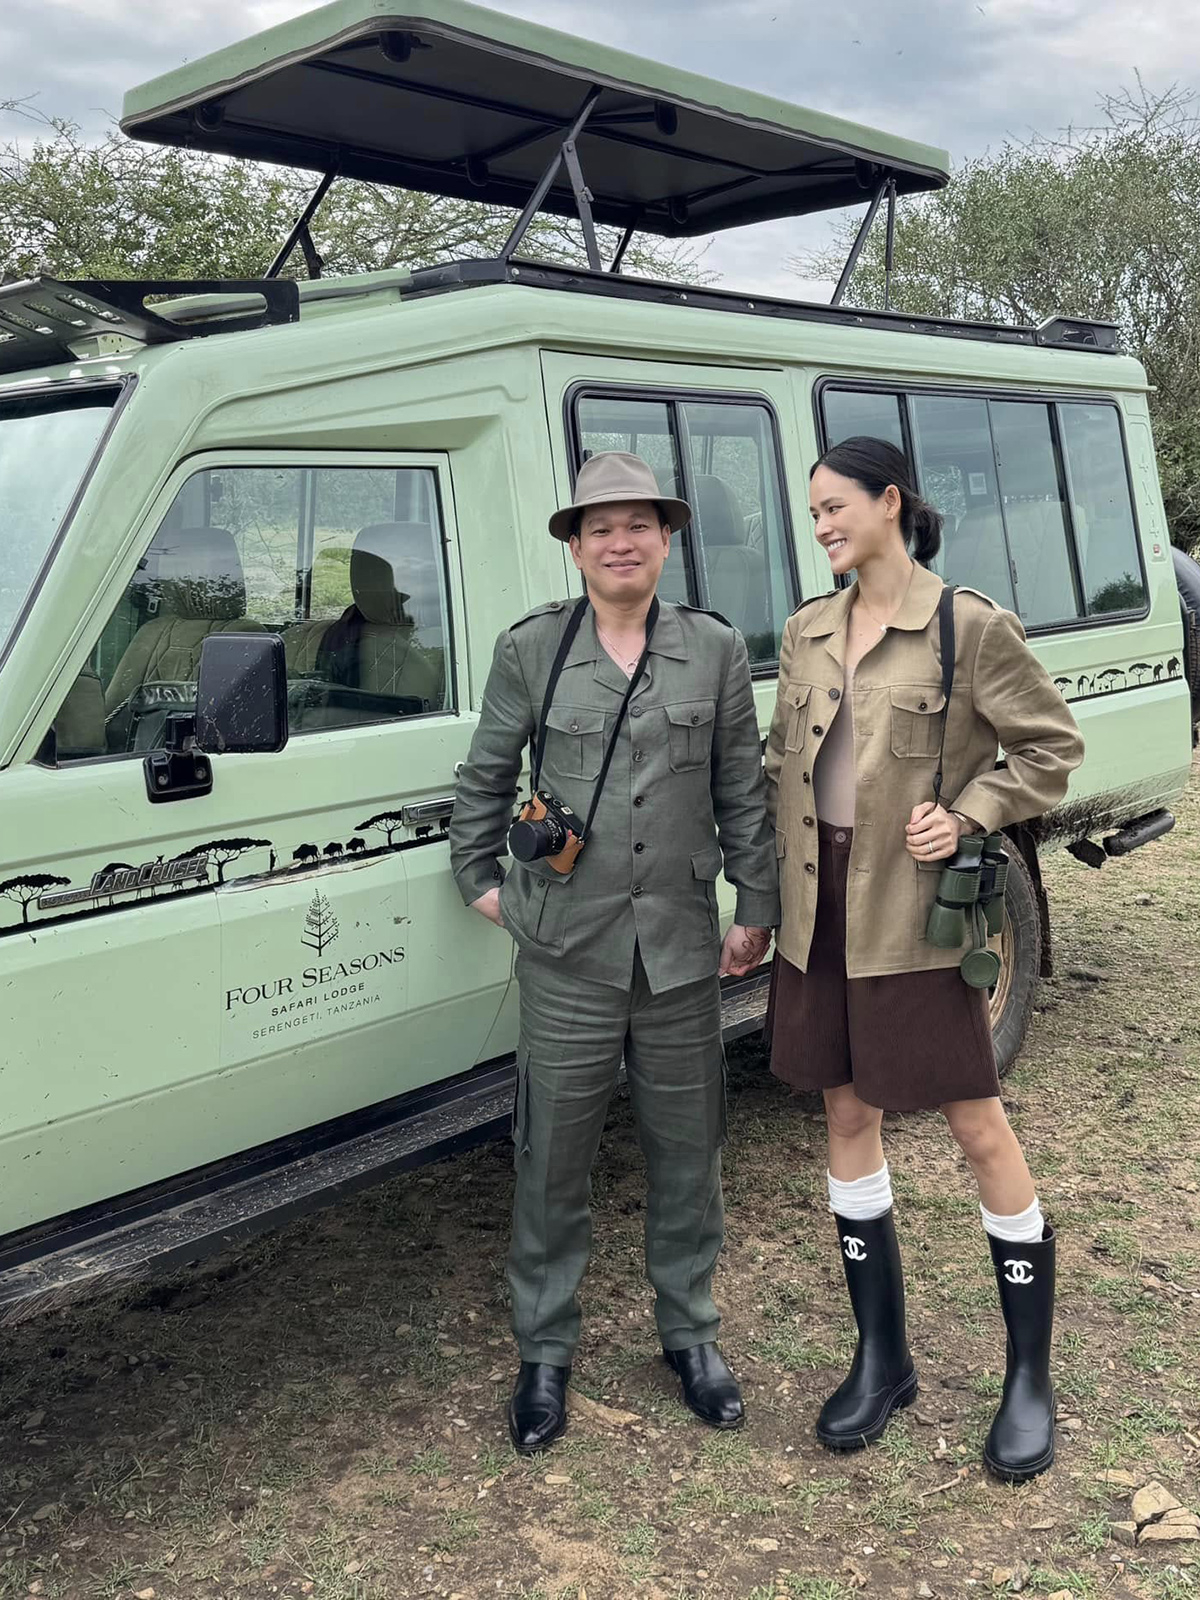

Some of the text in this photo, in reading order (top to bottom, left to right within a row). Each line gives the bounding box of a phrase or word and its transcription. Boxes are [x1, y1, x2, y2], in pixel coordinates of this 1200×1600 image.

[225, 946, 405, 1010] FOUR SEASONS
[271, 982, 365, 1017] SAFARI LODGE
[252, 994, 381, 1039] SERENGETI, TANZANIA
